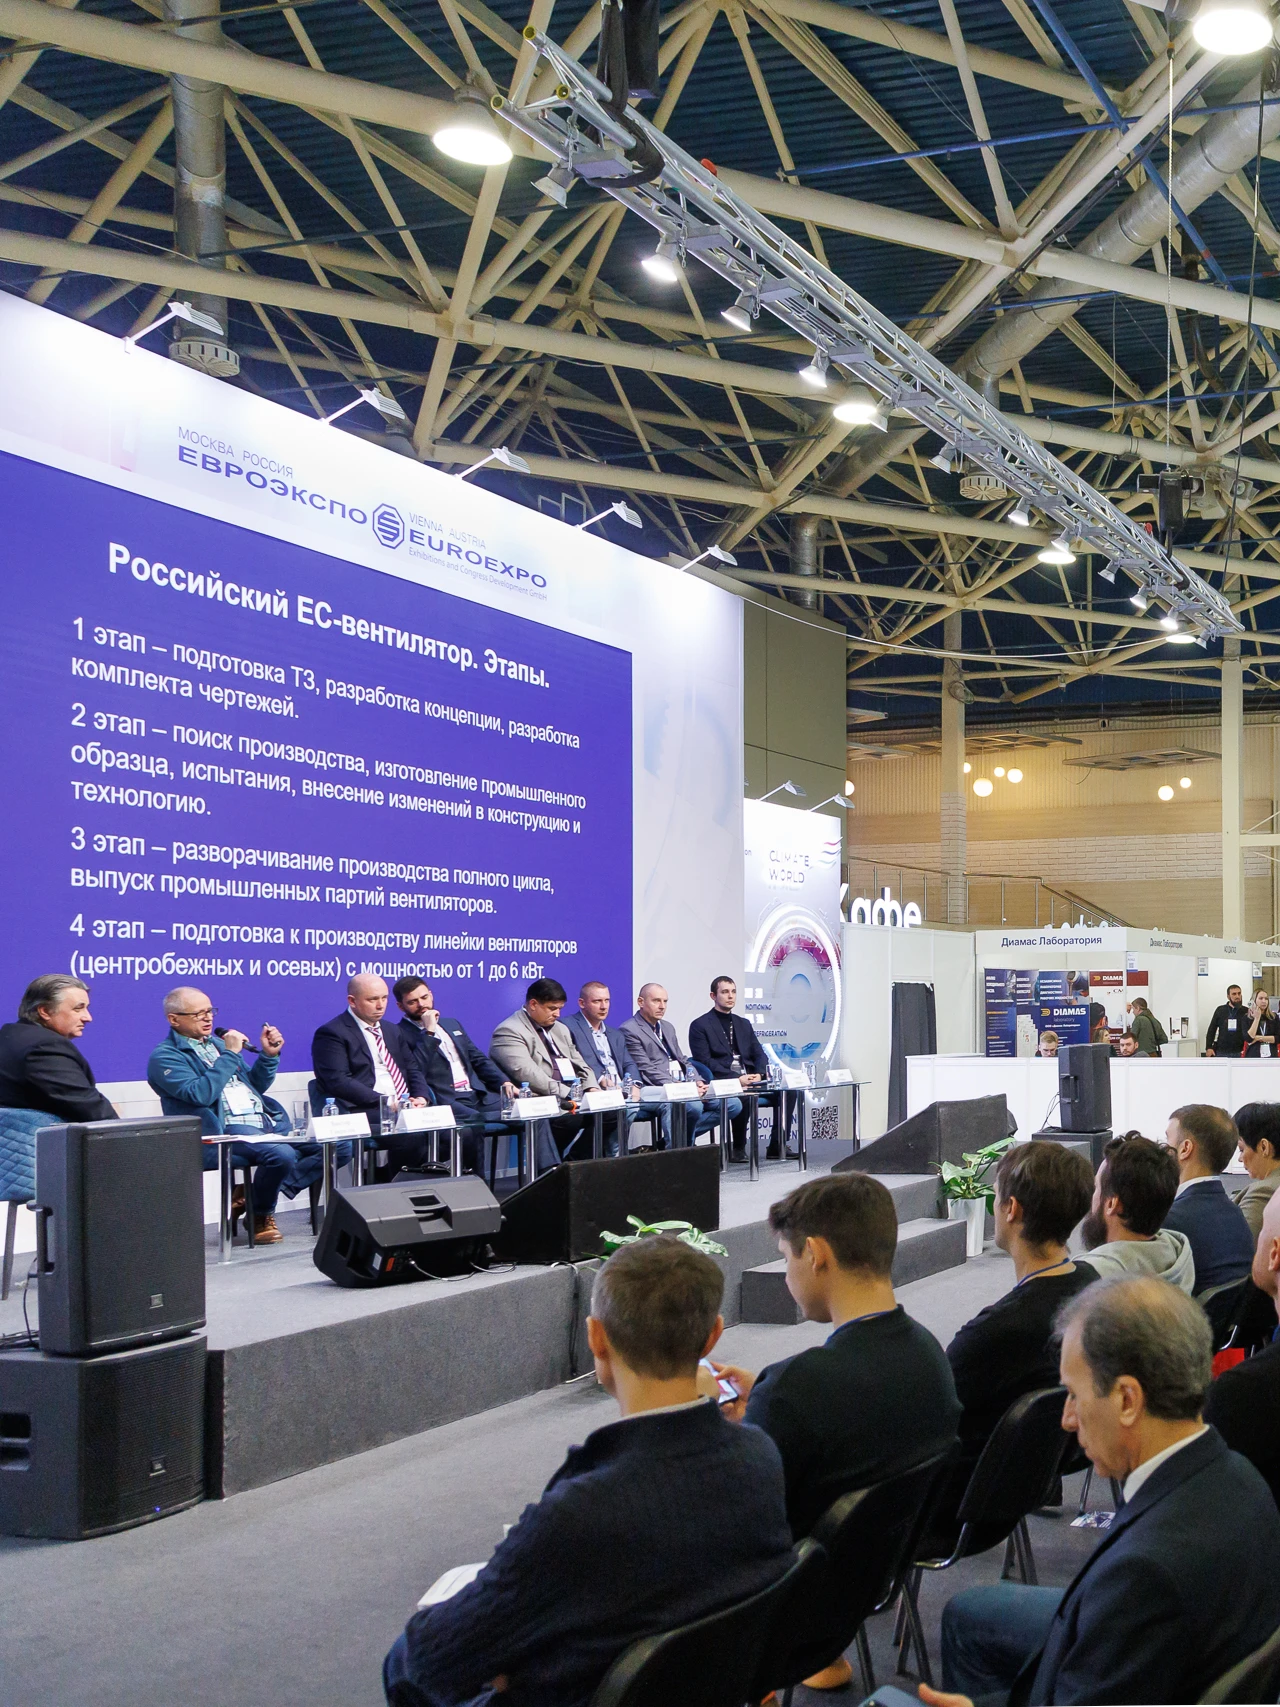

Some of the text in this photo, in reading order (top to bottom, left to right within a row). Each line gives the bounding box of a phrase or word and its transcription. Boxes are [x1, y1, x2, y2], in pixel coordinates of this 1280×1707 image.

[178, 426, 294, 479] МОСКВА РОССИЯ
[178, 444, 368, 525] ЕВРОЭКСПО
[409, 512, 486, 550] VIENNA AUSTRIA
[409, 529, 547, 588] EUROEXPO
[409, 547, 548, 601] Exhibitions and Congress Development GmbH
[109, 541, 550, 688] Российский ЕС-вентилятор. Этапы.
[71, 657, 300, 719] комплекта чертежей.
[73, 616, 84, 641] 1
[93, 626, 146, 654] этап
[173, 643, 285, 685] подготовка
[290, 665, 321, 696] ТЗ,
[325, 678, 421, 715] разработка
[424, 700, 505, 735] концепции,
[508, 719, 580, 749] разработка
[71, 702, 86, 727] 2
[93, 711, 146, 737] этап
[173, 725, 233, 751] поиск
[238, 736, 370, 777] производства,
[375, 759, 478, 792] изготовление
[481, 778, 587, 810] промышленного
[70, 741, 581, 834] образца, испытания, внесение изменений в конструкцию и
[71, 780, 212, 816] технологию.
[71, 826, 86, 851] 3
[92, 833, 146, 856] этап
[172, 841, 334, 872] разворачивание
[339, 857, 450, 884] производства
[453, 868, 510, 889] полного
[512, 874, 555, 895] цикла,
[768, 868, 805, 884] WORLD
[769, 850, 810, 867] CLIMATE
[70, 867, 498, 916] выпуск промышленных партий вентиляторов.
[69, 913, 85, 938] 4
[92, 919, 145, 940] этап
[172, 922, 285, 945] подготовка
[290, 928, 300, 945] к
[304, 928, 420, 953] производству
[423, 931, 485, 952] линейки
[488, 937, 578, 957] вентиляторов
[1001, 936, 1102, 949] Диамас Лаборатория
[70, 950, 546, 982] (центробежных и осевых) с мощностью от 1 до 6 кВт.
[1053, 1008, 1087, 1016] DIAMAS
